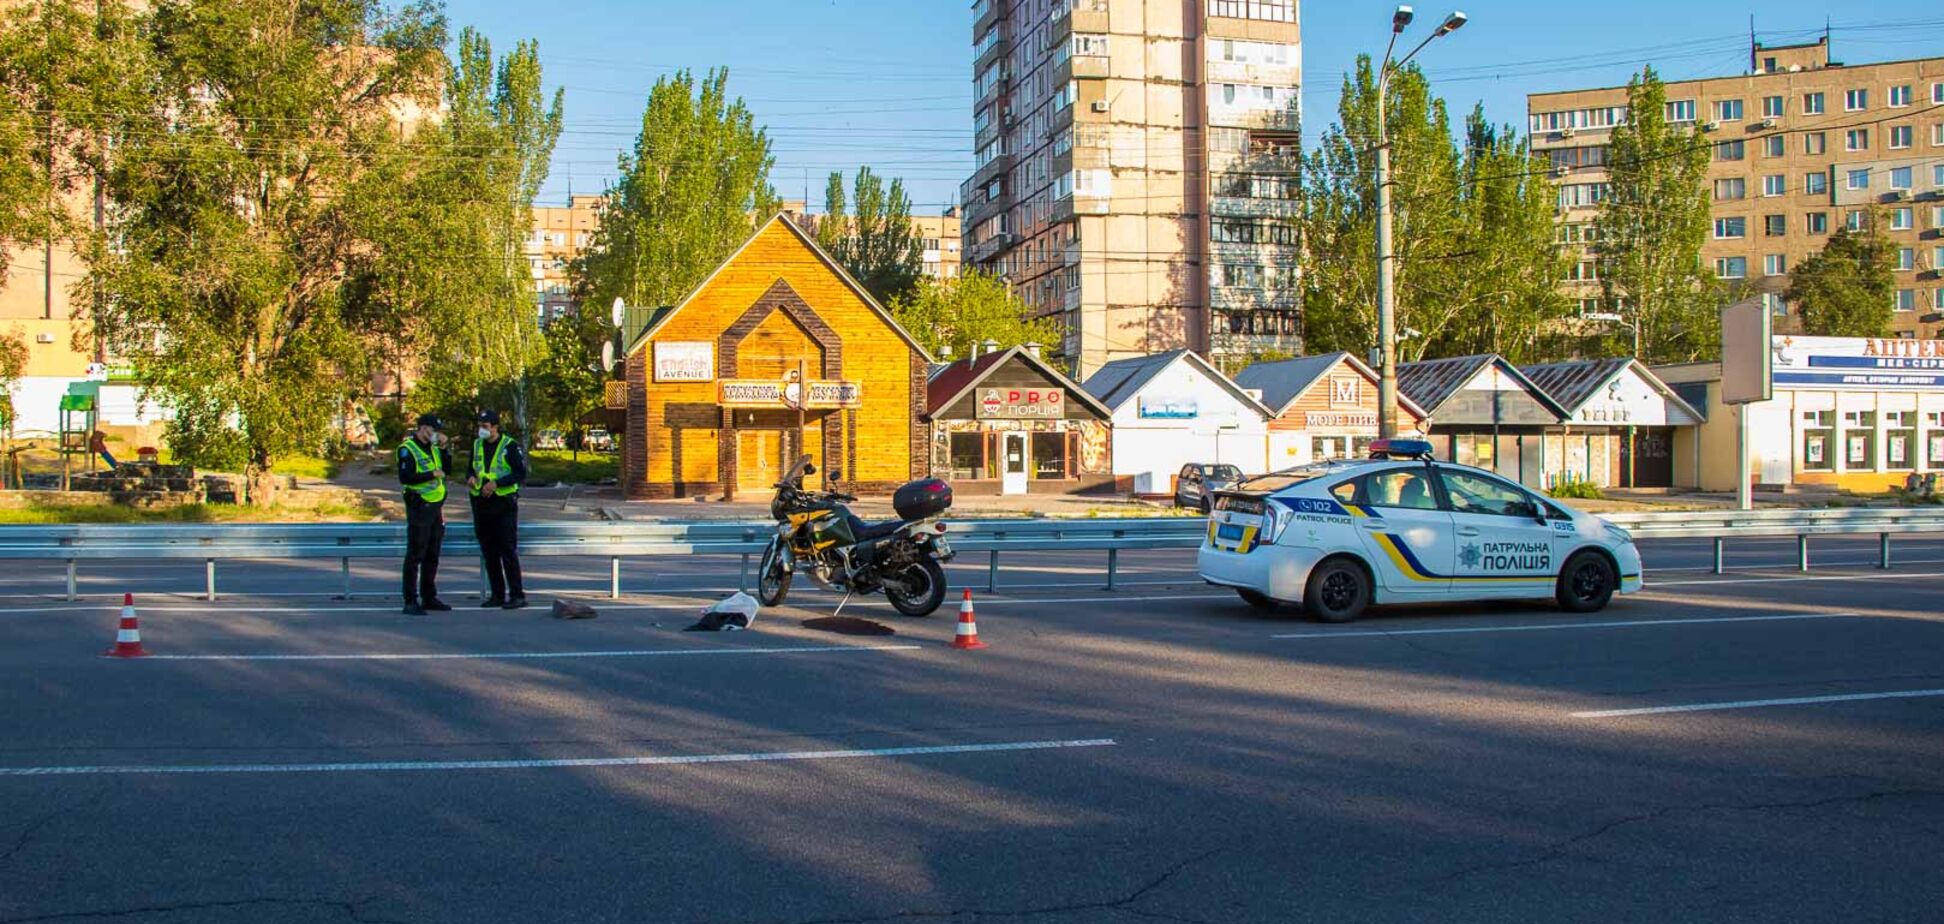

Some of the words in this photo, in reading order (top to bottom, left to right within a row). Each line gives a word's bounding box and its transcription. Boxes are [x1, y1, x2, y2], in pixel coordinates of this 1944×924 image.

[1008, 405, 1060, 417] ПОРЦІЯ
[1312, 501, 1332, 512] 102
[1296, 514, 1326, 523] PATROL
[1327, 516, 1352, 525] POLICE
[1483, 543, 1550, 553] ПАТРУЛЬНА
[1483, 555, 1550, 570] ПОЛІЦІЯ
